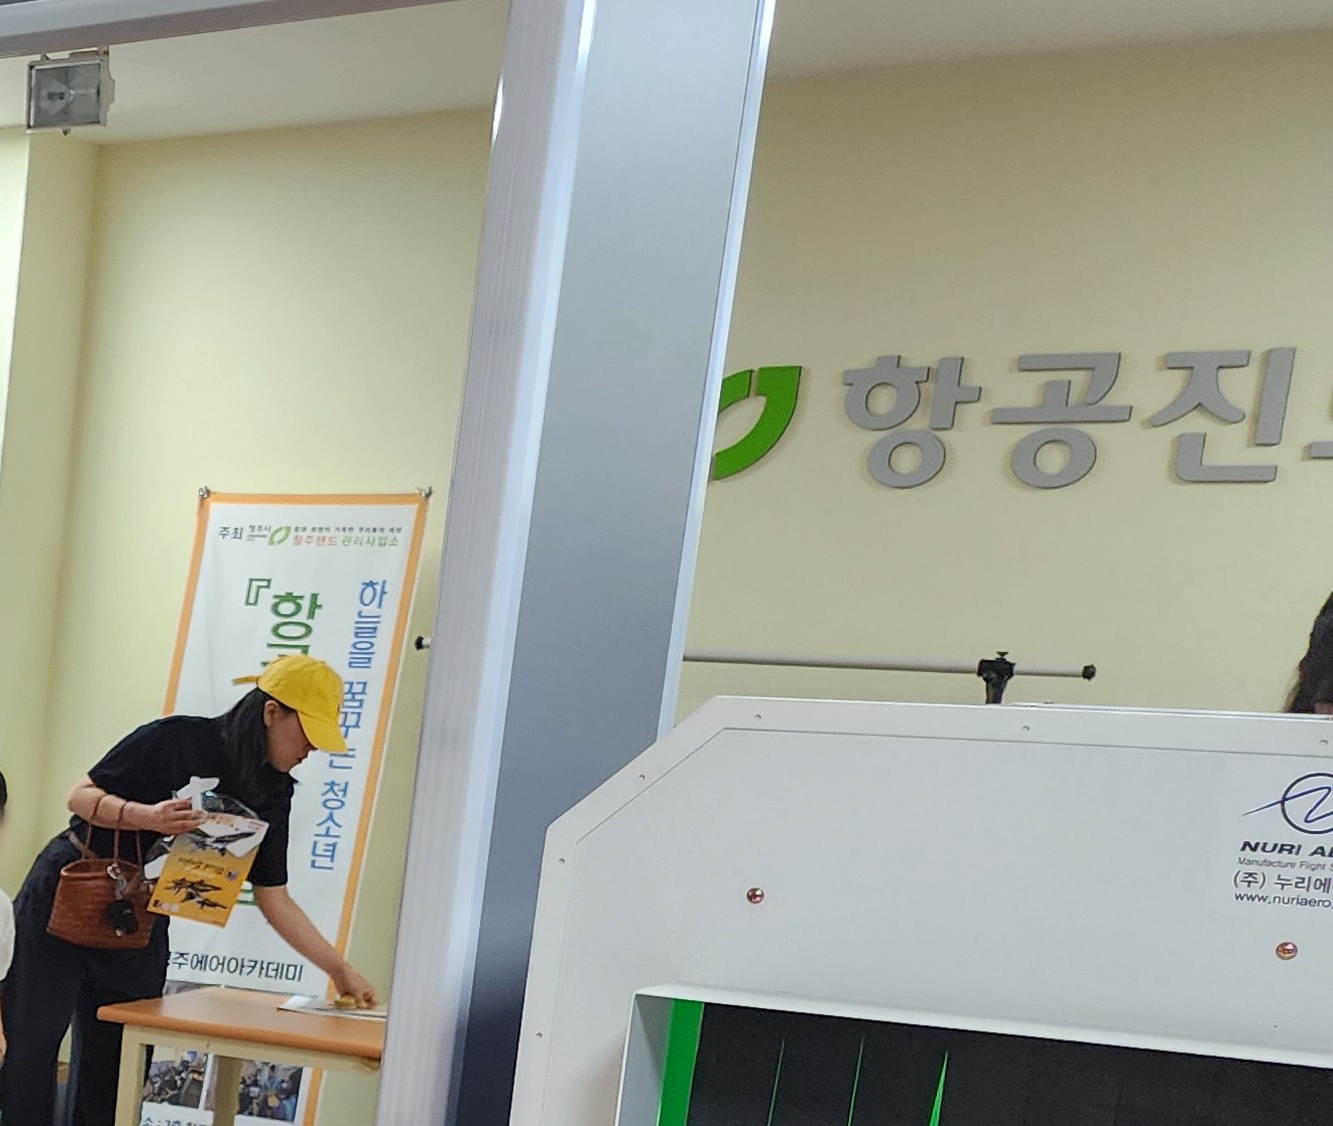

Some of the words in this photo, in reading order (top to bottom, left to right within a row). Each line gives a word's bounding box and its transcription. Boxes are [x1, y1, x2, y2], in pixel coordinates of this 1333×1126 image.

[842, 346, 1333, 489] 항공진
[348, 579, 388, 669] 하늘을
[310, 780, 349, 871] 청소년
[1240, 841, 1302, 855] NURI
[1299, 861, 1326, 871] Flight
[1233, 870, 1266, 889] (주)
[1274, 874, 1333, 894] 누리에
[168, 951, 304, 982] 주에어아카데미
